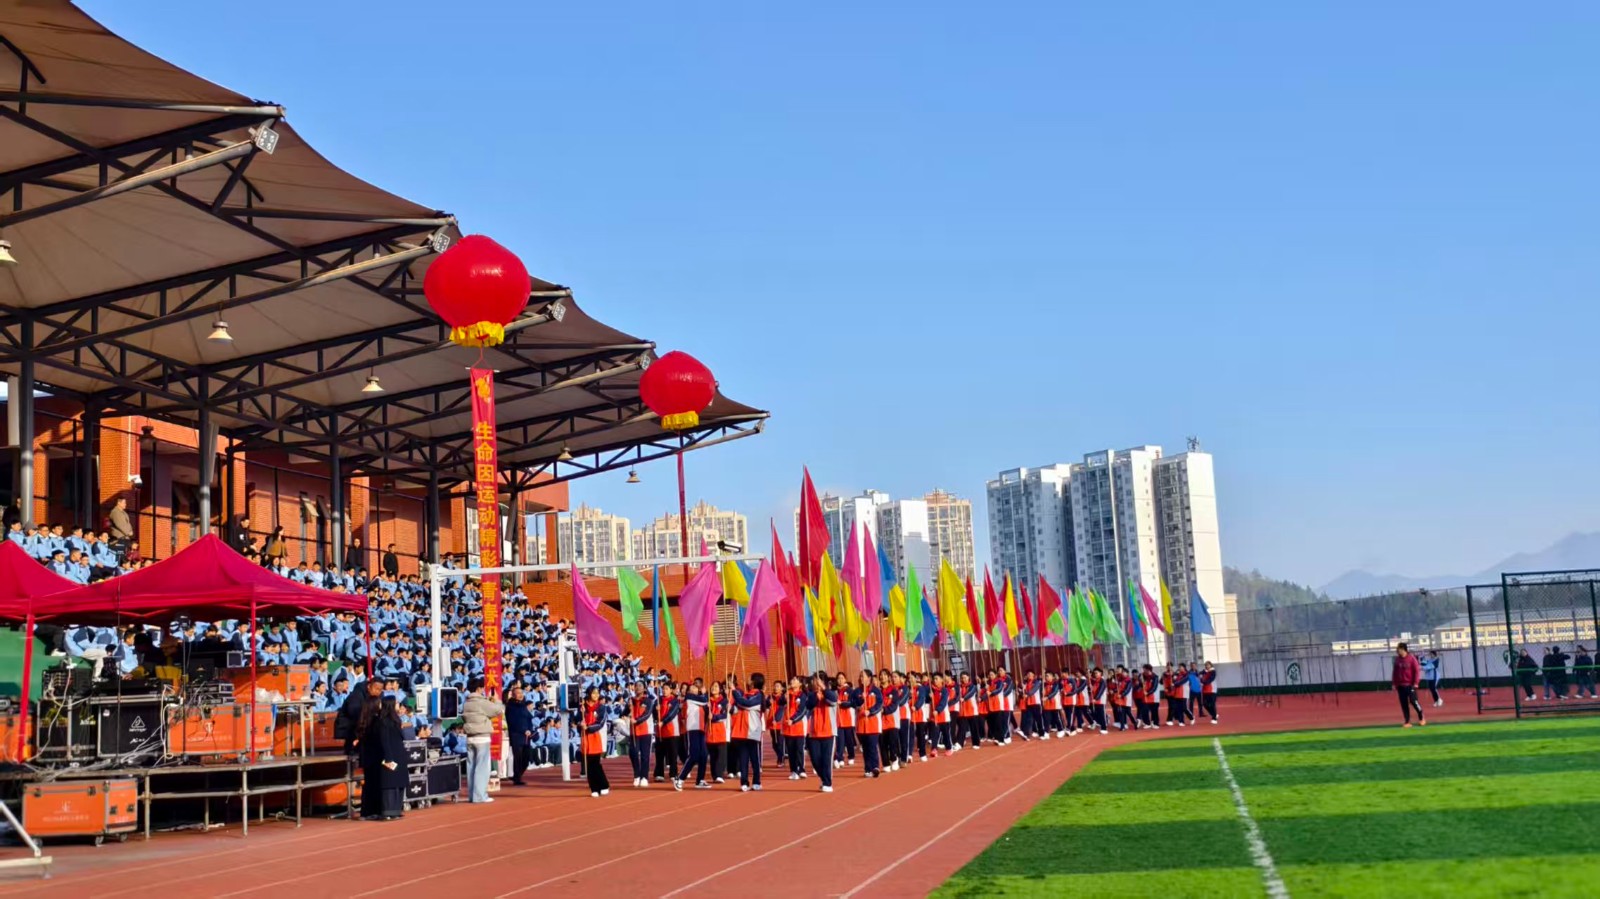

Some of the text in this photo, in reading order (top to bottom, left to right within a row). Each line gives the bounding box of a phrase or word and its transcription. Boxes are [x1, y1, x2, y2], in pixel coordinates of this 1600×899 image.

[475, 420, 497, 568] 生命因运动精彩
